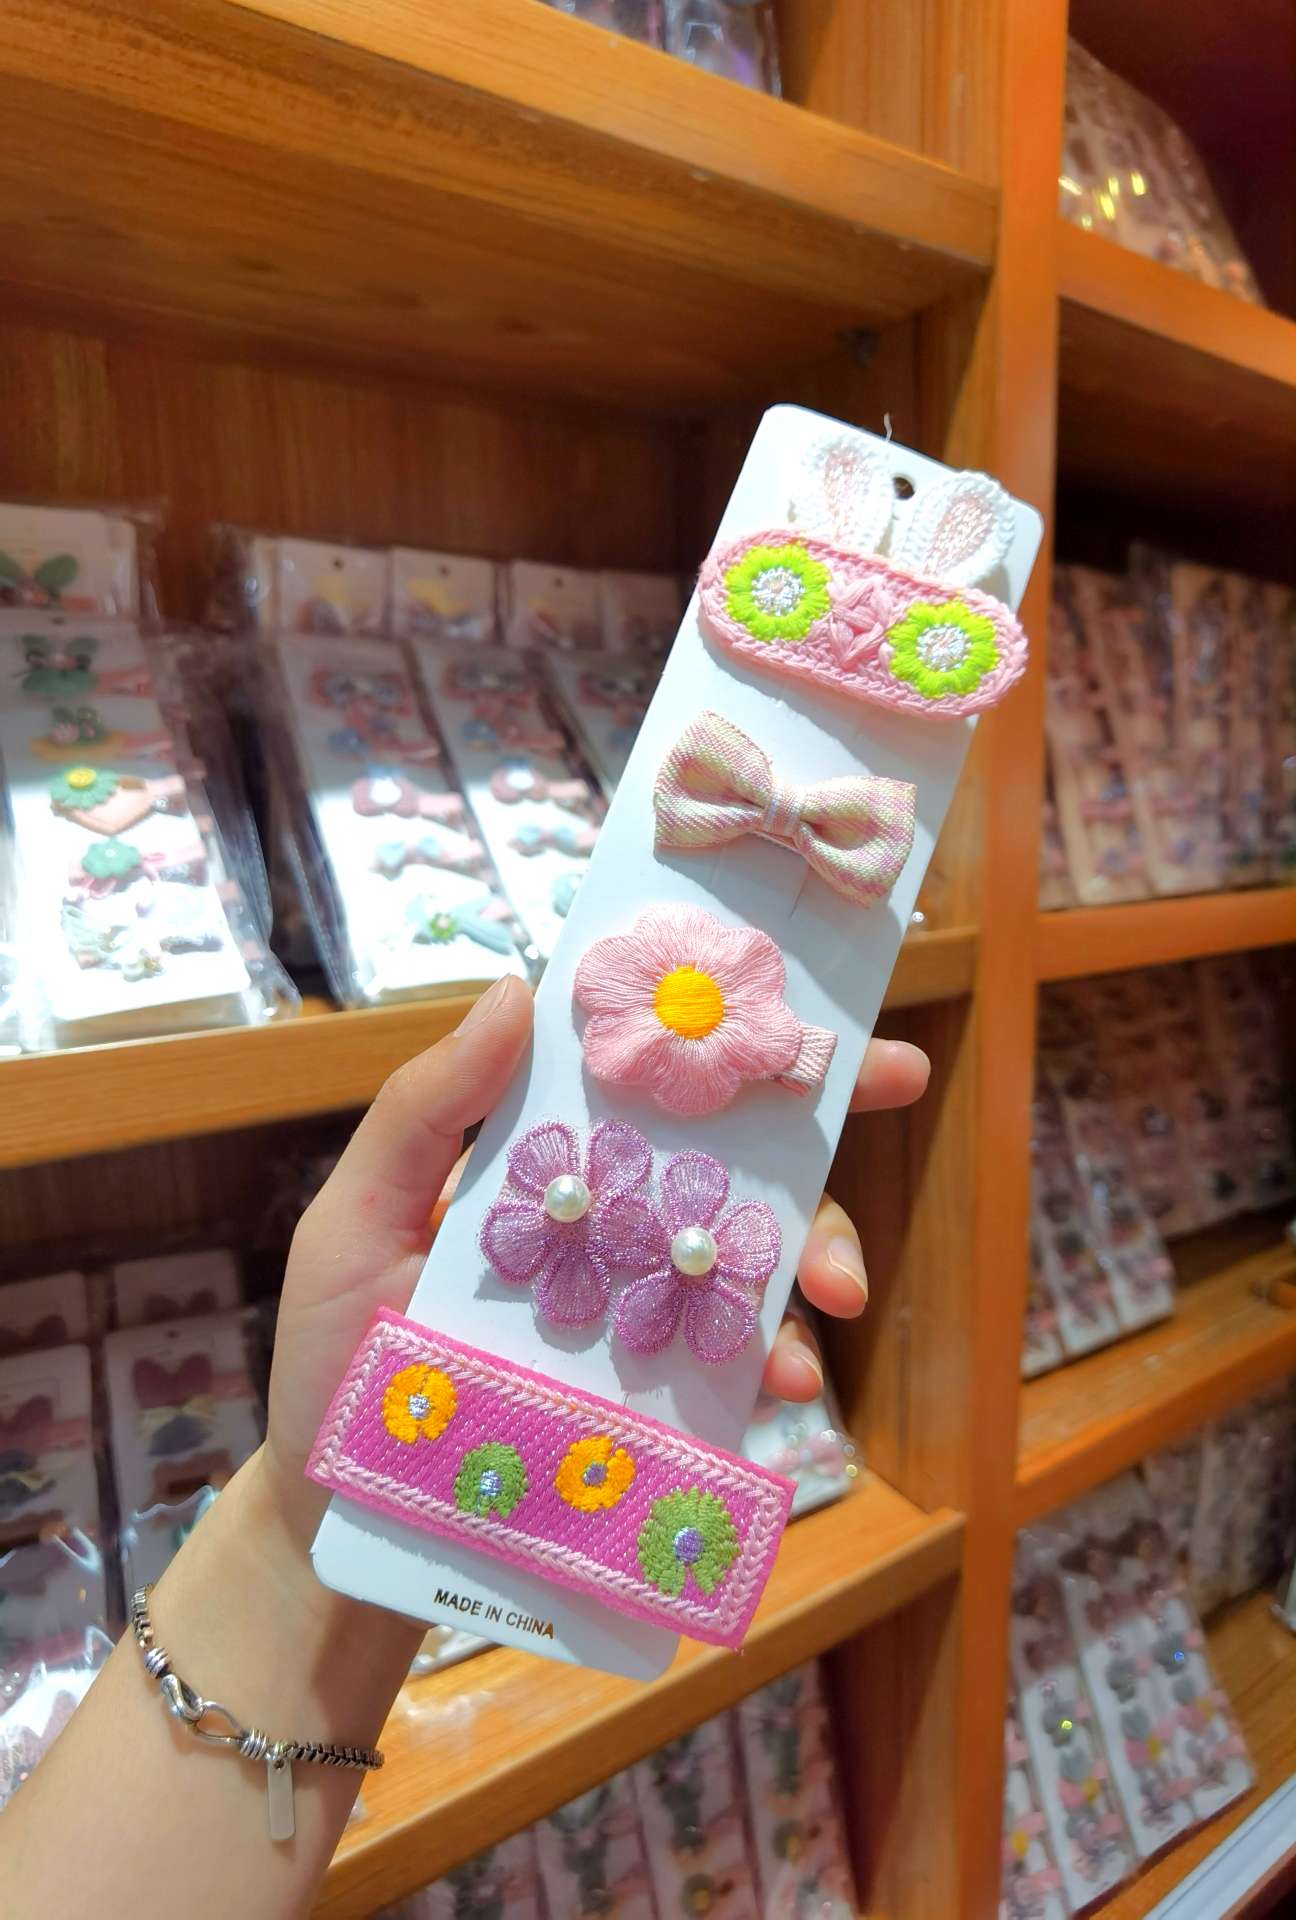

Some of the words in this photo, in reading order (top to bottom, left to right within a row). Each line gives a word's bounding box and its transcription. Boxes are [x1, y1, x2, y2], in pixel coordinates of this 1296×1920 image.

[434, 1588, 482, 1616] MADE
[485, 1604, 503, 1623] IN
[506, 1612, 554, 1640] CHINA
